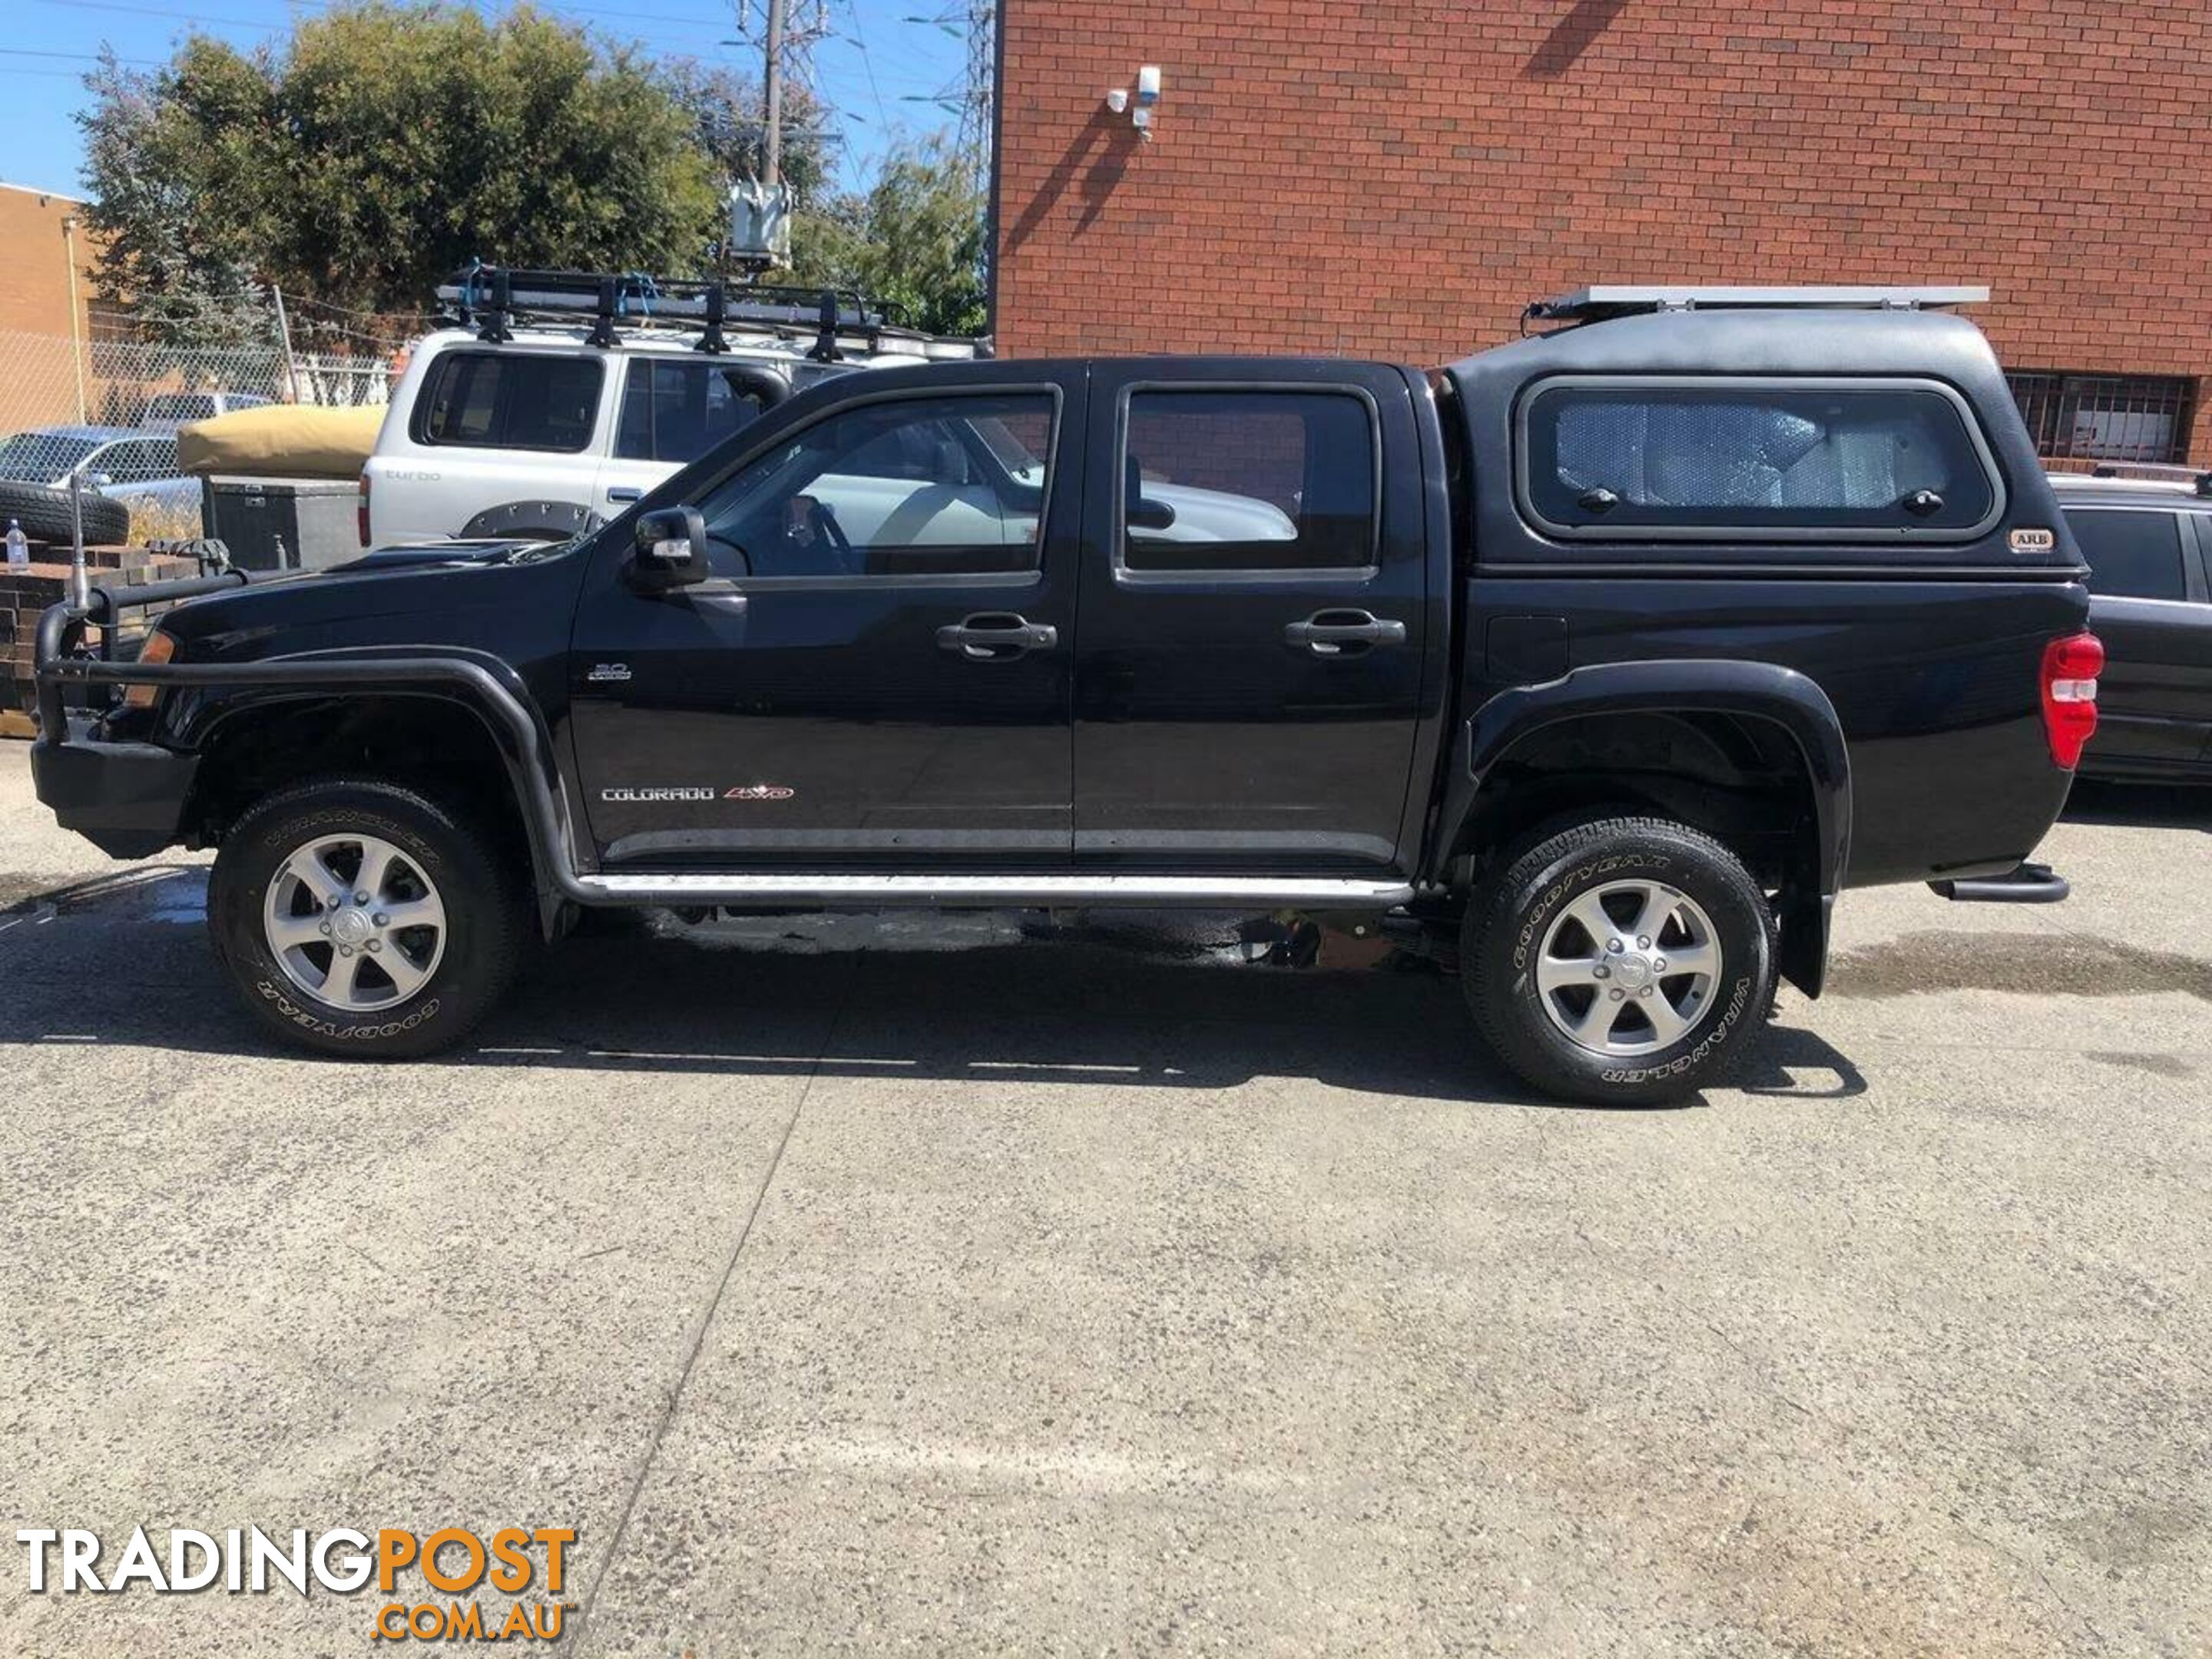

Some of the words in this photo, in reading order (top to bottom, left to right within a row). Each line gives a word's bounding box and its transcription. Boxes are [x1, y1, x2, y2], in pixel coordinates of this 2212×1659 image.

[2017, 535, 2048, 545] ARB
[601, 787, 714, 801] COLORADO
[1512, 853, 1672, 969] GOODYEAR
[257, 980, 440, 1039] GOODYEAR
[1601, 977, 1751, 1083] WRANGLER
